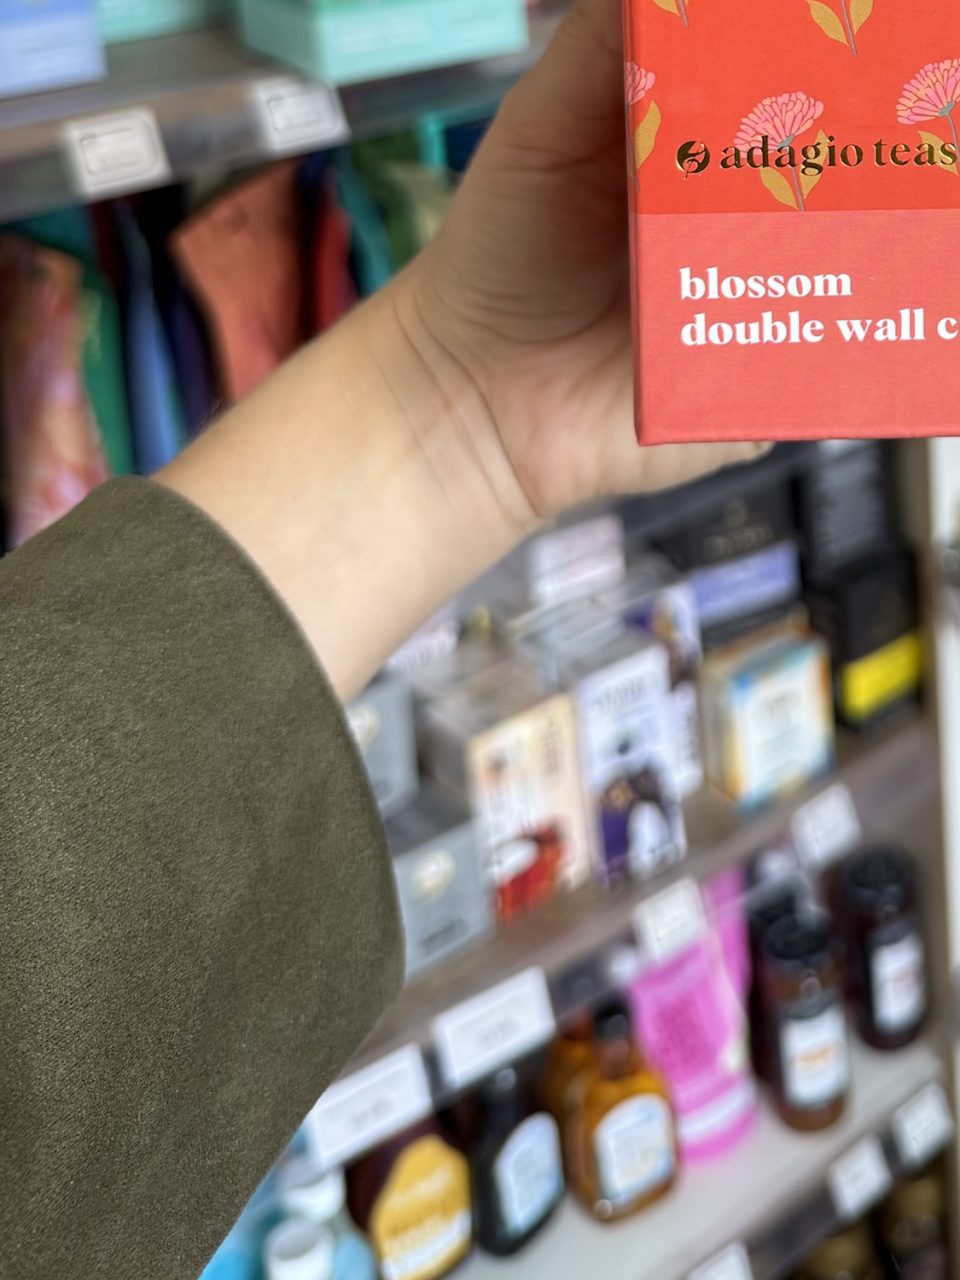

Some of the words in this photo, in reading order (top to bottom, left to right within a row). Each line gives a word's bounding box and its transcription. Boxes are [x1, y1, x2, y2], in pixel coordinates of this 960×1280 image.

[720, 134, 863, 177] adagio
[872, 138, 959, 167] teas
[679, 266, 853, 300] blossom
[680, 311, 825, 346] double
[835, 307, 926, 342] wall
